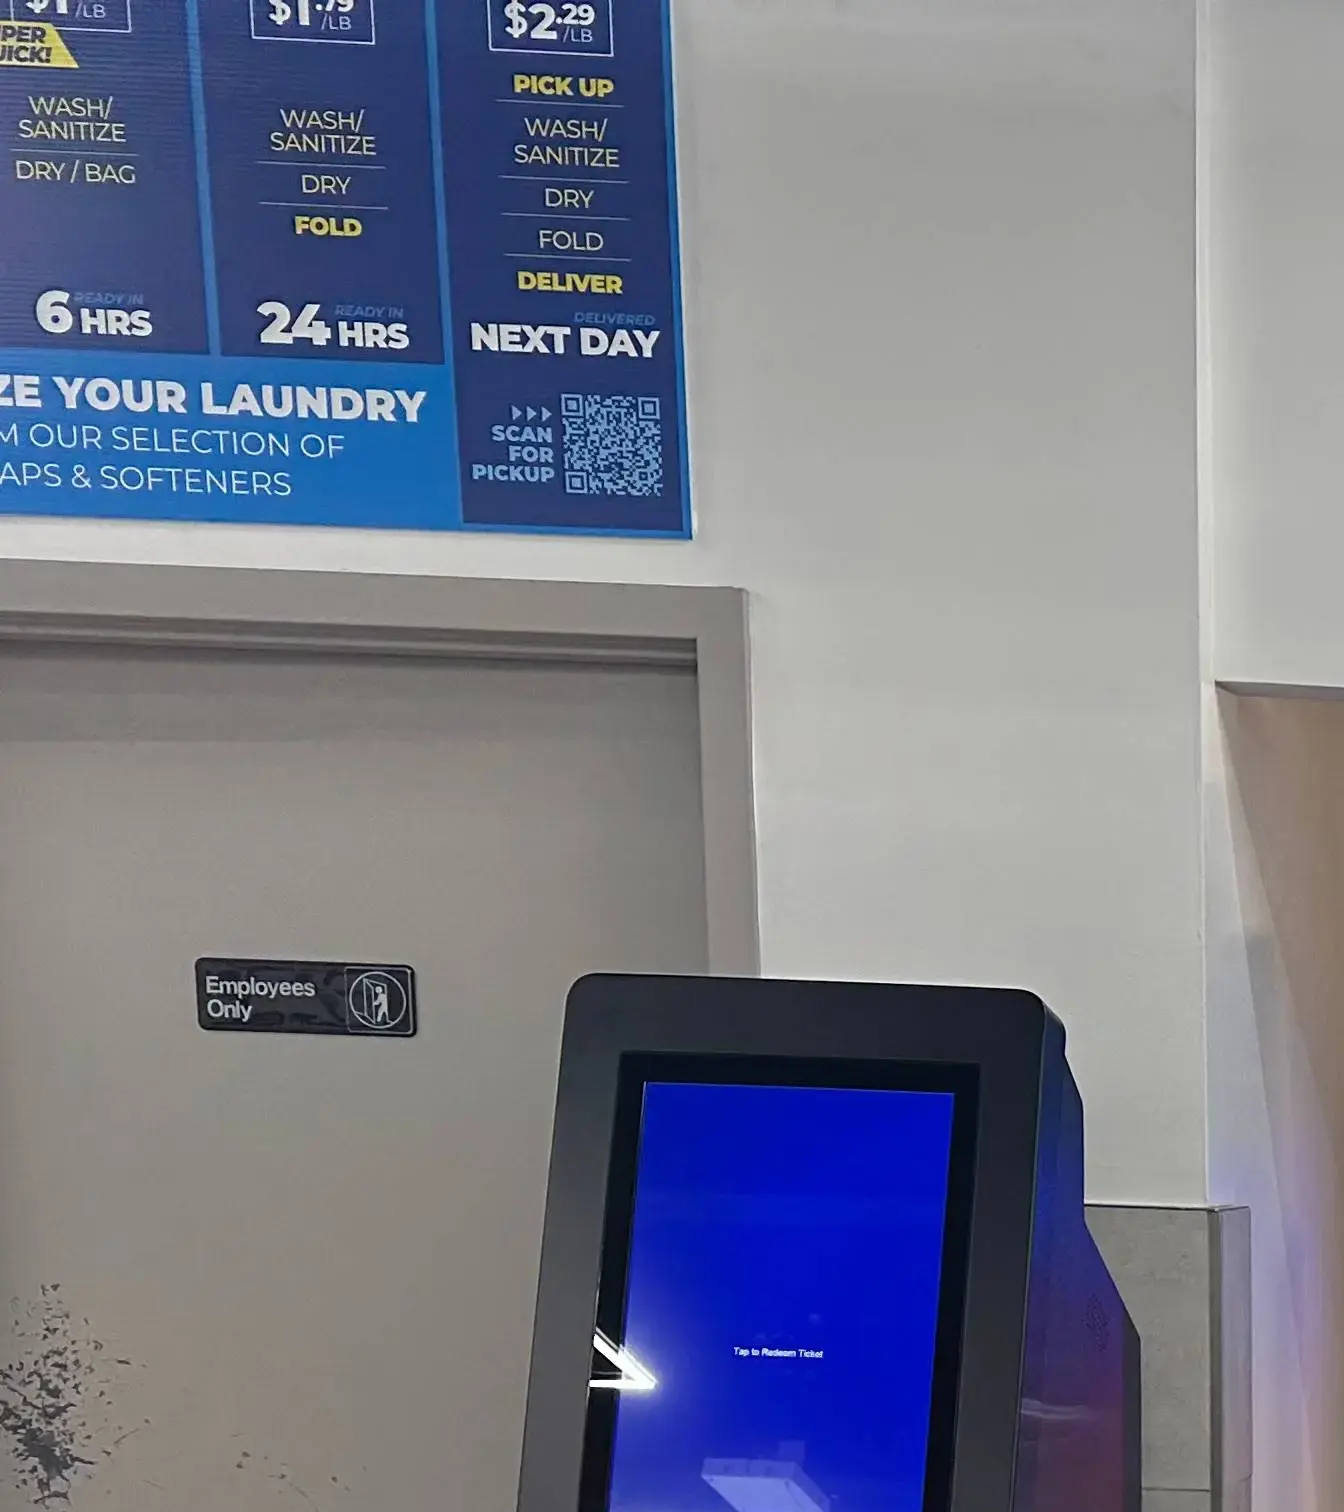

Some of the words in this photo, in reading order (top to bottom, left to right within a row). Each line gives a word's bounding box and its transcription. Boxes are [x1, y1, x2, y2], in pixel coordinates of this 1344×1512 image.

[75, 3, 106, 18] /LB
[321, 13, 352, 30] /LB
[504, 1, 595, 39] $2.29
[563, 27, 594, 43] /LB
[514, 75, 573, 96] PICK
[579, 77, 614, 98] UP
[28, 96, 114, 120] WASH/
[18, 120, 127, 143] SANITIZE
[280, 109, 365, 133] WASH/
[524, 118, 608, 142] WASH/
[270, 132, 376, 156] SANITIZE
[514, 145, 620, 168] SANITIZE
[15, 160, 65, 183] DRY
[85, 162, 136, 184] BAG
[302, 175, 351, 195] DRY
[545, 188, 594, 208] DRY
[295, 216, 362, 238] FOLD
[539, 230, 604, 251] FOLD
[517, 271, 623, 294] DELIVER
[36, 290, 73, 333] 6
[81, 307, 153, 337] HRS
[334, 304, 384, 318] READY
[388, 305, 403, 318] IN
[574, 312, 655, 326] DELIVERED
[257, 301, 331, 346] 24
[338, 321, 410, 350] HRS
[470, 323, 571, 354] NEXT
[580, 328, 661, 358] DAY
[52, 376, 187, 414] YOUR
[201, 382, 426, 423] LAUNDRY
[30, 424, 102, 450] OUR
[112, 426, 291, 458] SELECTION
[301, 433, 345, 459] OF
[491, 425, 553, 443] SCAN
[509, 445, 554, 463] FOR
[72, 464, 92, 488] &
[100, 464, 292, 497] SOFTENERS
[472, 463, 555, 483] PICKUP
[206, 976, 316, 998] Employees
[207, 999, 252, 1021] Only
[733, 1347, 750, 1357] Tap
[751, 1348, 760, 1356] to
[761, 1347, 796, 1357] Redeem
[798, 1348, 824, 1358] Ticket
